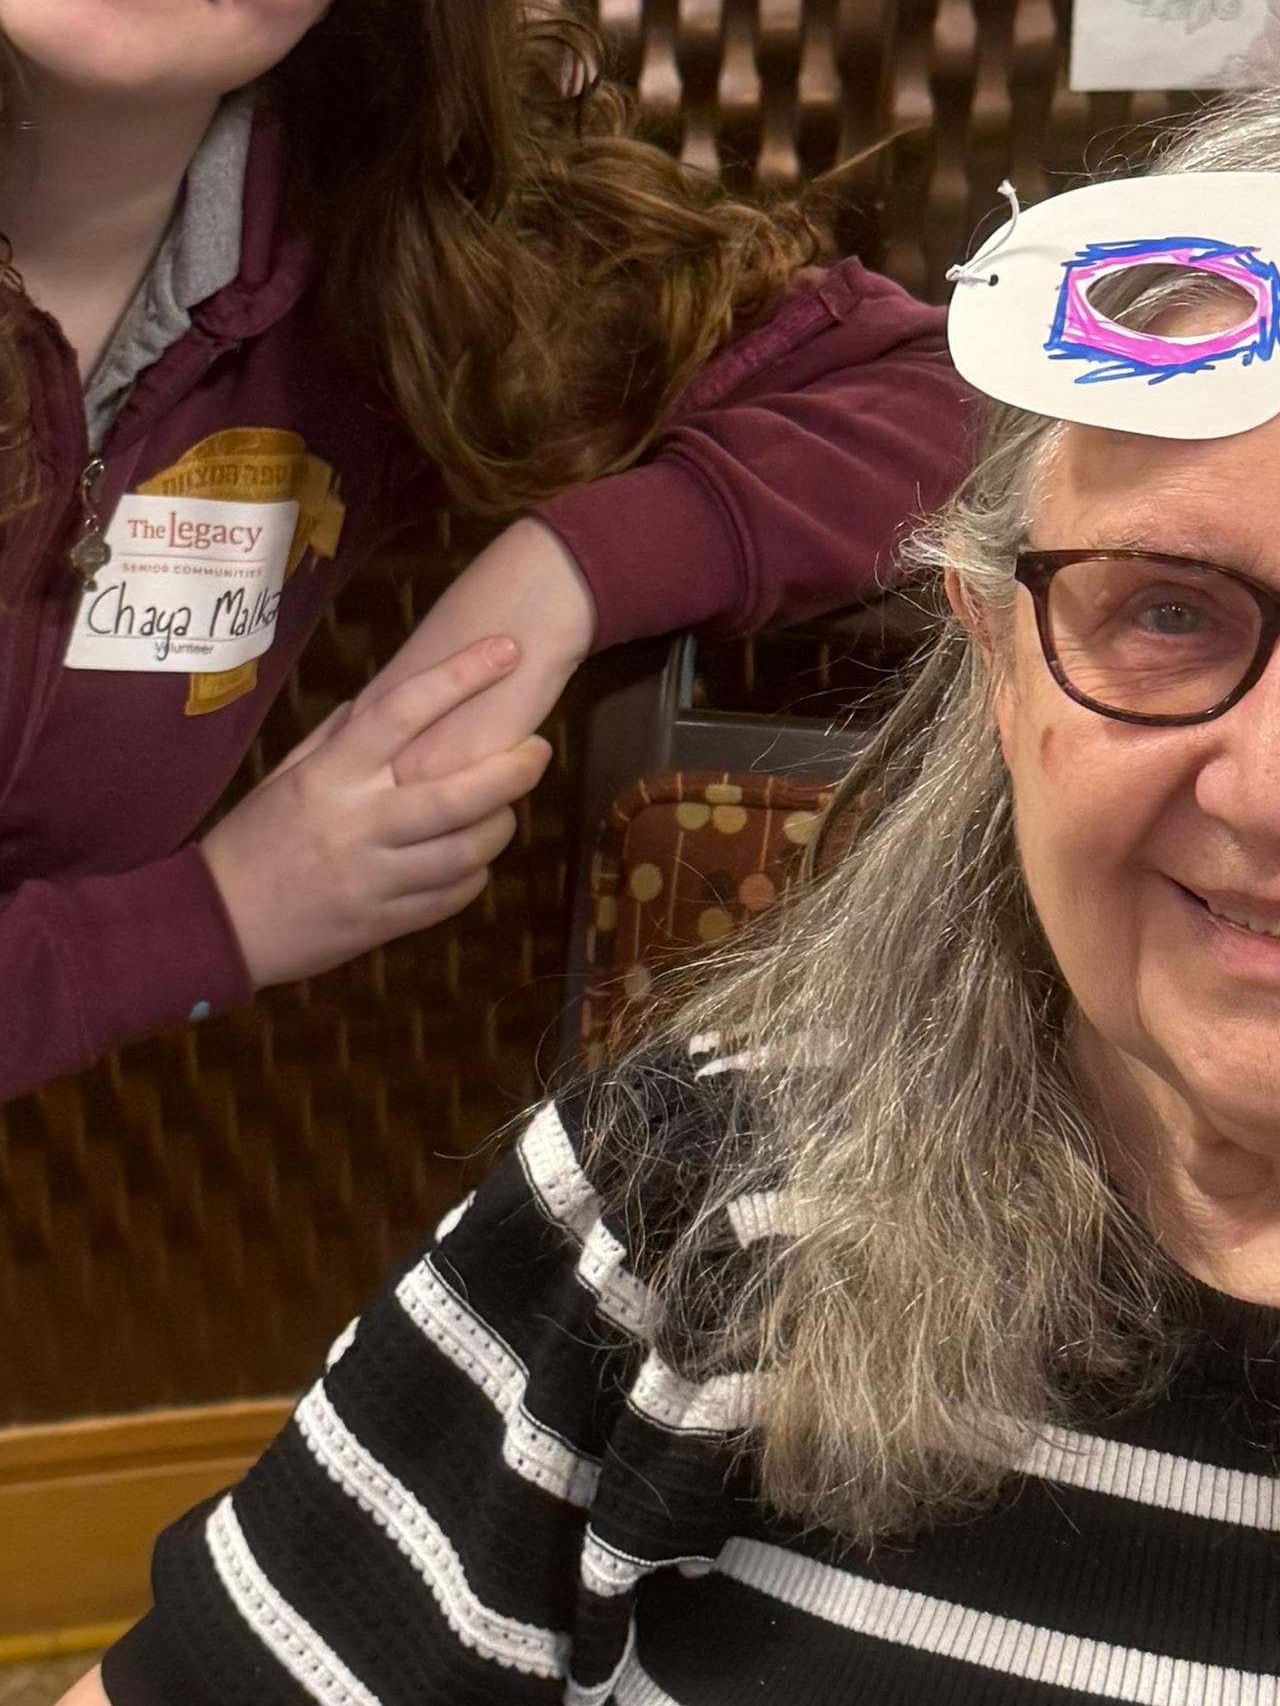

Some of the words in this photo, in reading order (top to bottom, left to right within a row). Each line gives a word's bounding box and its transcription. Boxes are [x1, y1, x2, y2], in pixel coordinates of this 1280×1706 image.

[128, 518, 166, 539] The
[168, 511, 263, 553] Legacy
[122, 563, 169, 574] SENIOR
[87, 581, 191, 661] Chaya
[155, 643, 214, 656] Volunteer
